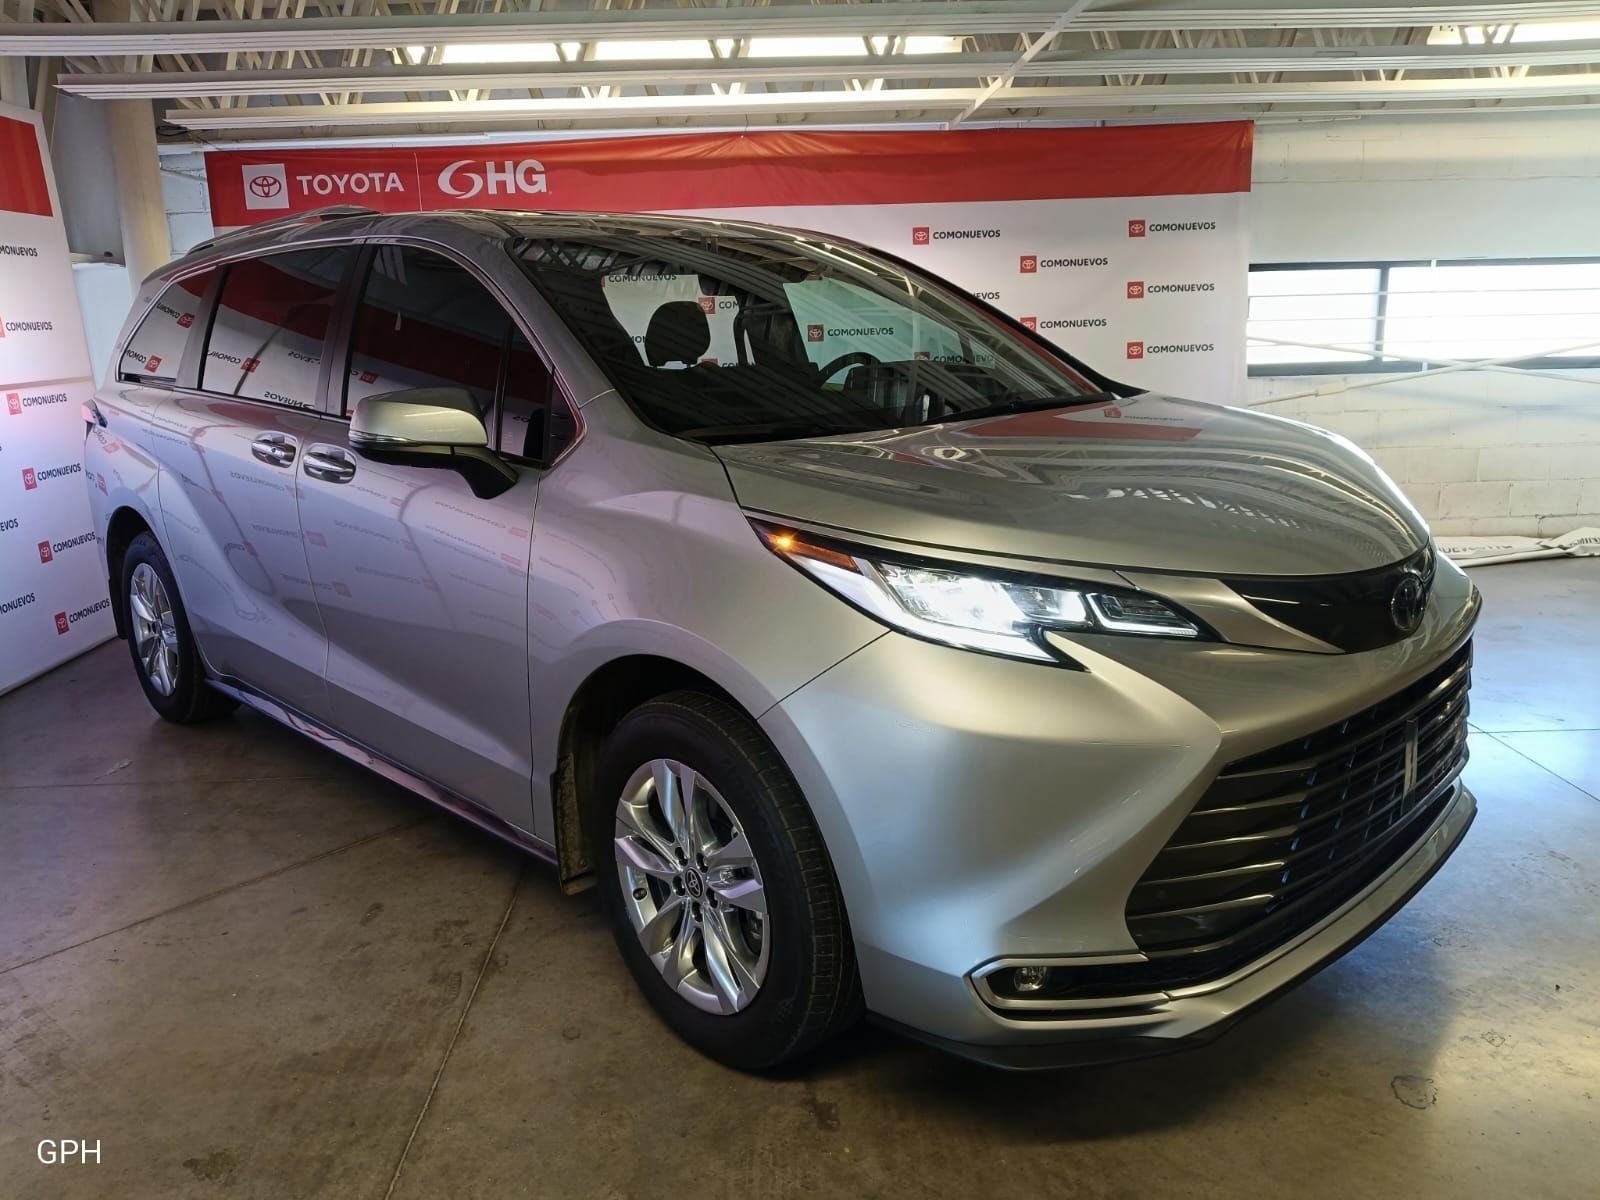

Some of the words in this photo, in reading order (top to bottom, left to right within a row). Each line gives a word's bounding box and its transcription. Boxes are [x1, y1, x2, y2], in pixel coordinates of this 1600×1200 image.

[296, 172, 405, 196] TOYOTA
[1149, 221, 1216, 232] COMONUEVOS
[932, 229, 1001, 240] COMONUEVOS
[1040, 256, 1109, 268] COMONUEVOS
[1147, 283, 1215, 294] COMONUEVOS
[5, 321, 53, 332] COMONUEVOS
[1040, 318, 1108, 330] COMONUEVOS
[827, 327, 895, 337] COMONUEVOS
[1147, 343, 1215, 355] COMONUEVOS
[22, 393, 67, 407] COMONUEVOS
[37, 463, 82, 482] COMONUEVOS
[52, 531, 96, 554] COMONUEVOS
[69, 598, 110, 623] COMONUEVOS
